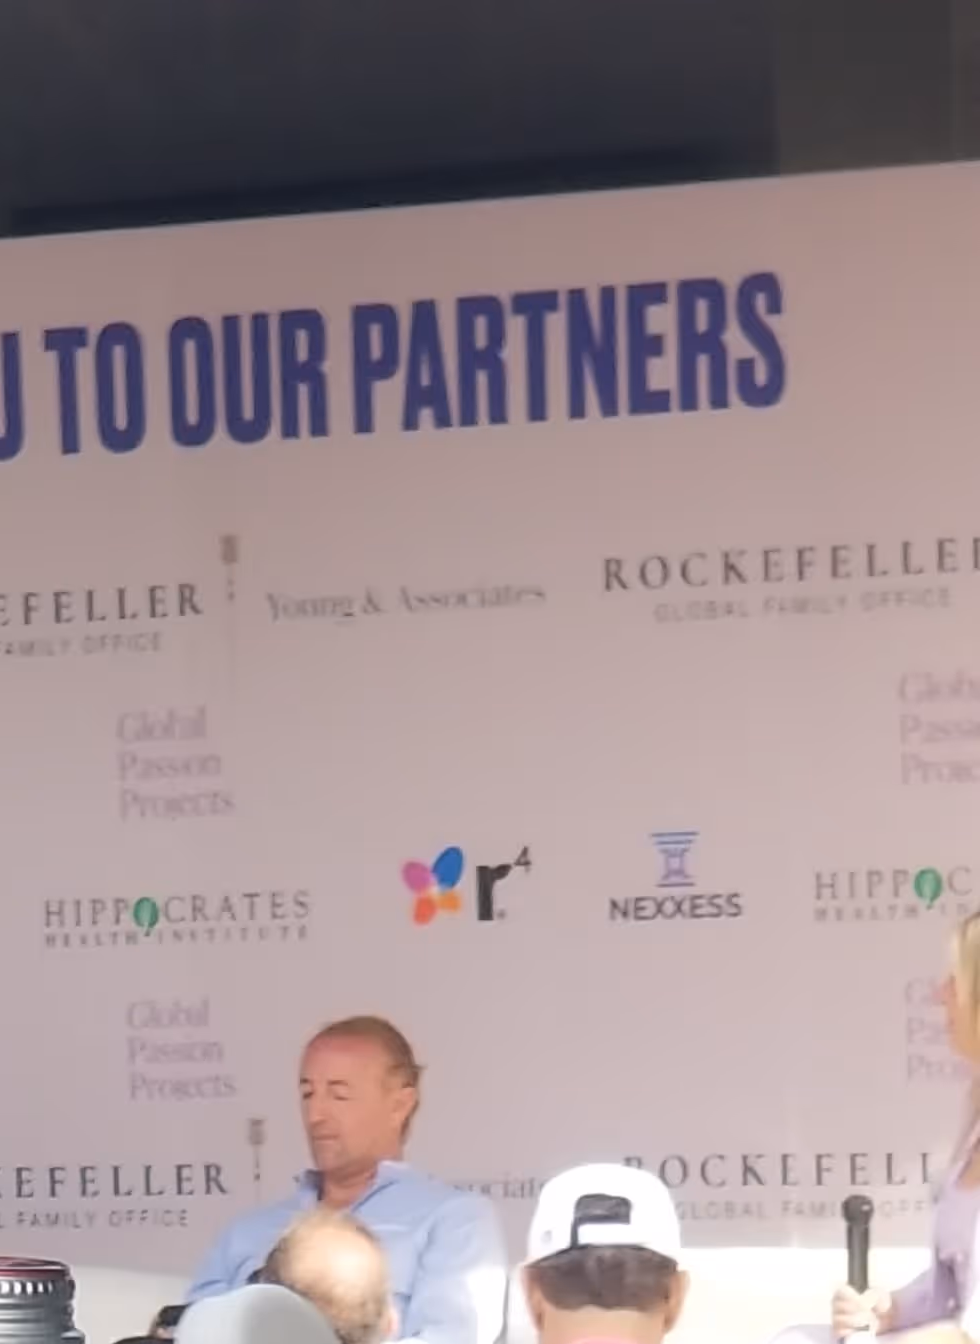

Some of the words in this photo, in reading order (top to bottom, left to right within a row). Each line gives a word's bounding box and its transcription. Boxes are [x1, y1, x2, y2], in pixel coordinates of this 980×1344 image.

[44, 321, 145, 455] TO
[168, 308, 328, 449] OUR
[352, 271, 785, 434] PARTNERS
[265, 591, 356, 625] Young
[362, 585, 384, 616] &
[399, 581, 546, 614] Associates
[653, 600, 750, 625] GLOBAL
[762, 594, 849, 616] FAMILY
[860, 587, 953, 612] OFFICE
[82, 632, 163, 655] OFFICE
[115, 704, 207, 742] Global
[116, 751, 222, 780] Passion
[119, 788, 235, 822] Projects
[609, 892, 743, 921] NEXXESS
[124, 996, 210, 1030] Global
[126, 1036, 224, 1065] Passion
[128, 1073, 236, 1102] Projects
[17, 1209, 98, 1228] FAMILY
[109, 1208, 189, 1227] OFFICE
